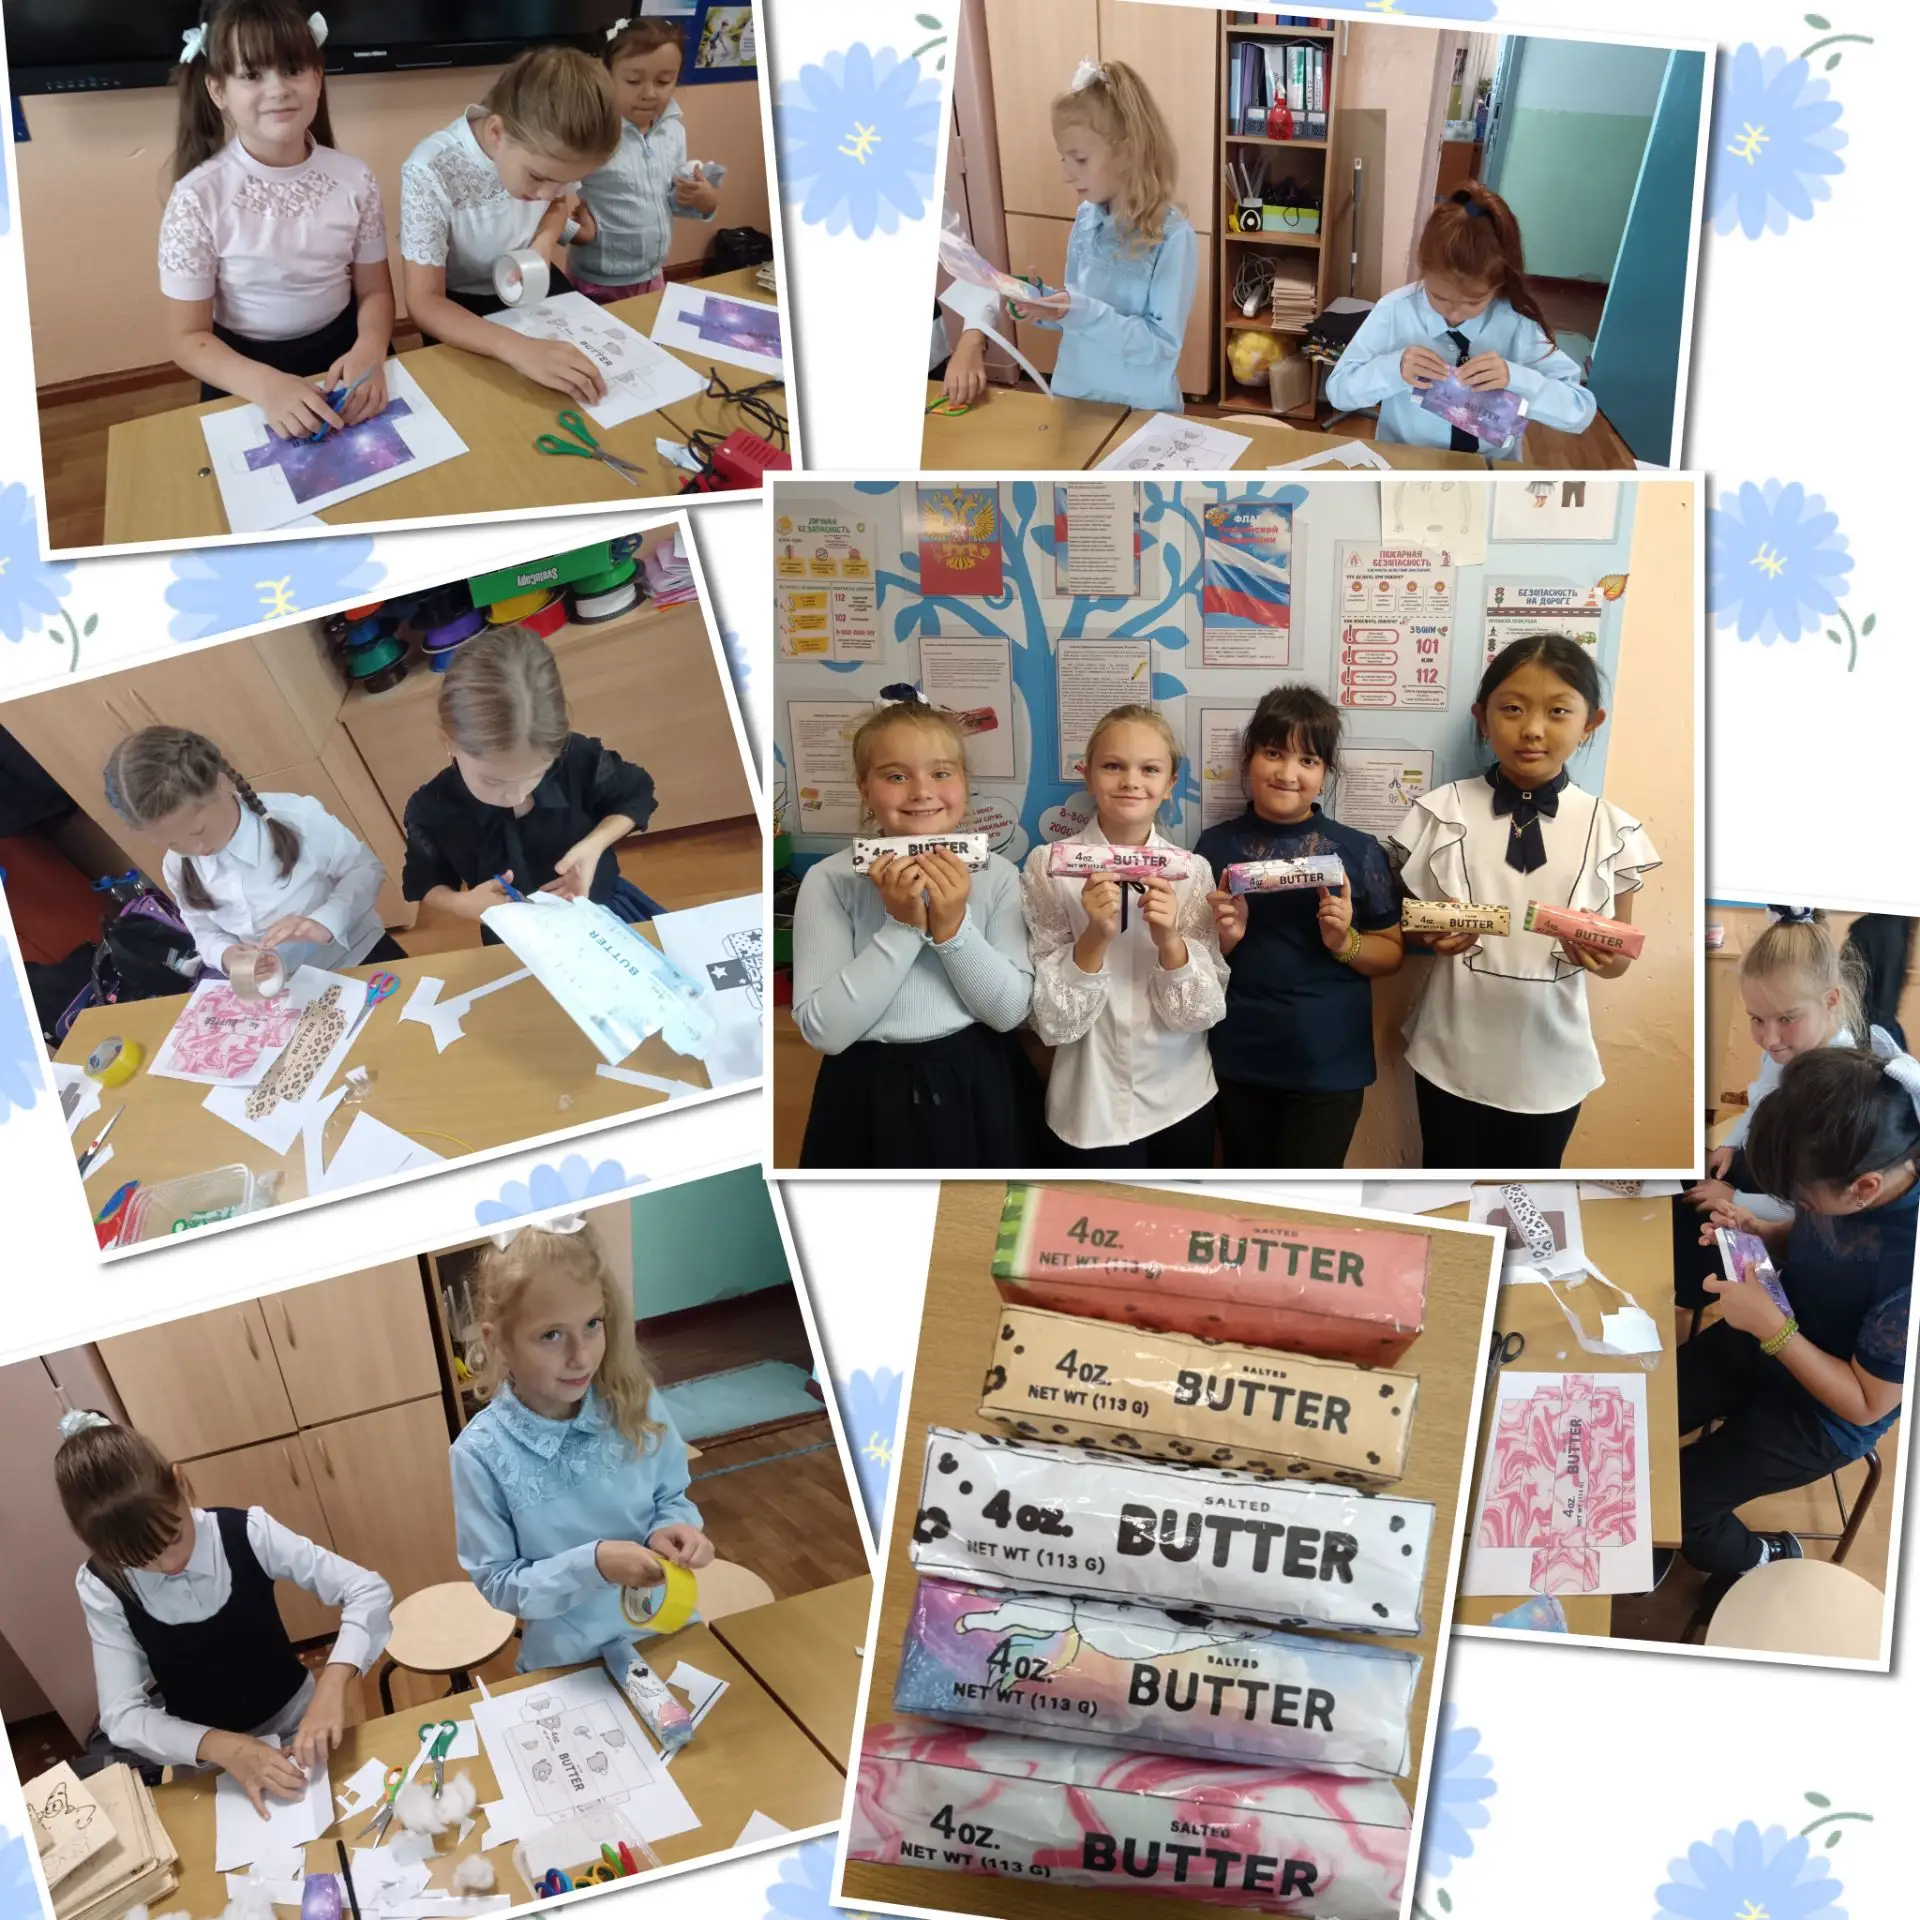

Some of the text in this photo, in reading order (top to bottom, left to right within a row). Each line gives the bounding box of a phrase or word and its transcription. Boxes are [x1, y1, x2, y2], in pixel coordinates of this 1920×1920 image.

[580, 340, 613, 366] BUTTER
[1464, 401, 1500, 423] BUTTER
[798, 525, 851, 534] БЕЗОПАСНОСТЬ
[1379, 550, 1423, 558] ПОЖАРНАЯ
[1372, 558, 1432, 568] БЕЗОПАСНОСТЬ
[835, 592, 846, 602] 112
[1518, 588, 1578, 598] БЕЗОПАСНОСТЬ
[1540, 598, 1571, 606] ДОРОГЕ
[835, 614, 846, 622] 102
[1410, 626, 1436, 634] ЗВОНИ
[1416, 638, 1439, 654] 101
[1416, 668, 1438, 684] 112
[1060, 808, 1090, 824] 8-800
[1113, 854, 1169, 868] BUTTER
[1280, 872, 1324, 885] BUTTER
[1450, 918, 1494, 930] BUTTER
[1575, 928, 1624, 948] BUTTER
[590, 930, 640, 976] BUTTER
[204, 1016, 239, 1027] BUTTER
[292, 1022, 317, 1055] BUTTER
[1252, 1227, 1299, 1238] SALTED
[1040, 1252, 1071, 1267] NET
[1076, 1256, 1101, 1269] WT
[1188, 1229, 1365, 1287] BUTTER
[1242, 1365, 1287, 1379] SALTED
[1028, 1384, 1150, 1418] NET WT (113 G)
[1174, 1369, 1351, 1436] BUTTER
[1567, 1418, 1582, 1475] BUTTER
[1204, 1496, 1270, 1512] SALTED
[1116, 1502, 1358, 1584] BUTTER
[967, 1539, 1106, 1575] NET WT (113 G)
[1206, 1655, 1260, 1669] SALTED
[953, 1682, 1098, 1718] NET WT (113 G)
[1127, 1662, 1336, 1733] BUTTER
[558, 1752, 584, 1792] BUTTER
[1170, 1820, 1231, 1839] SALTED
[900, 1840, 1051, 1879] NET WT (113 G)
[1083, 1832, 1318, 1898] BUTTER
